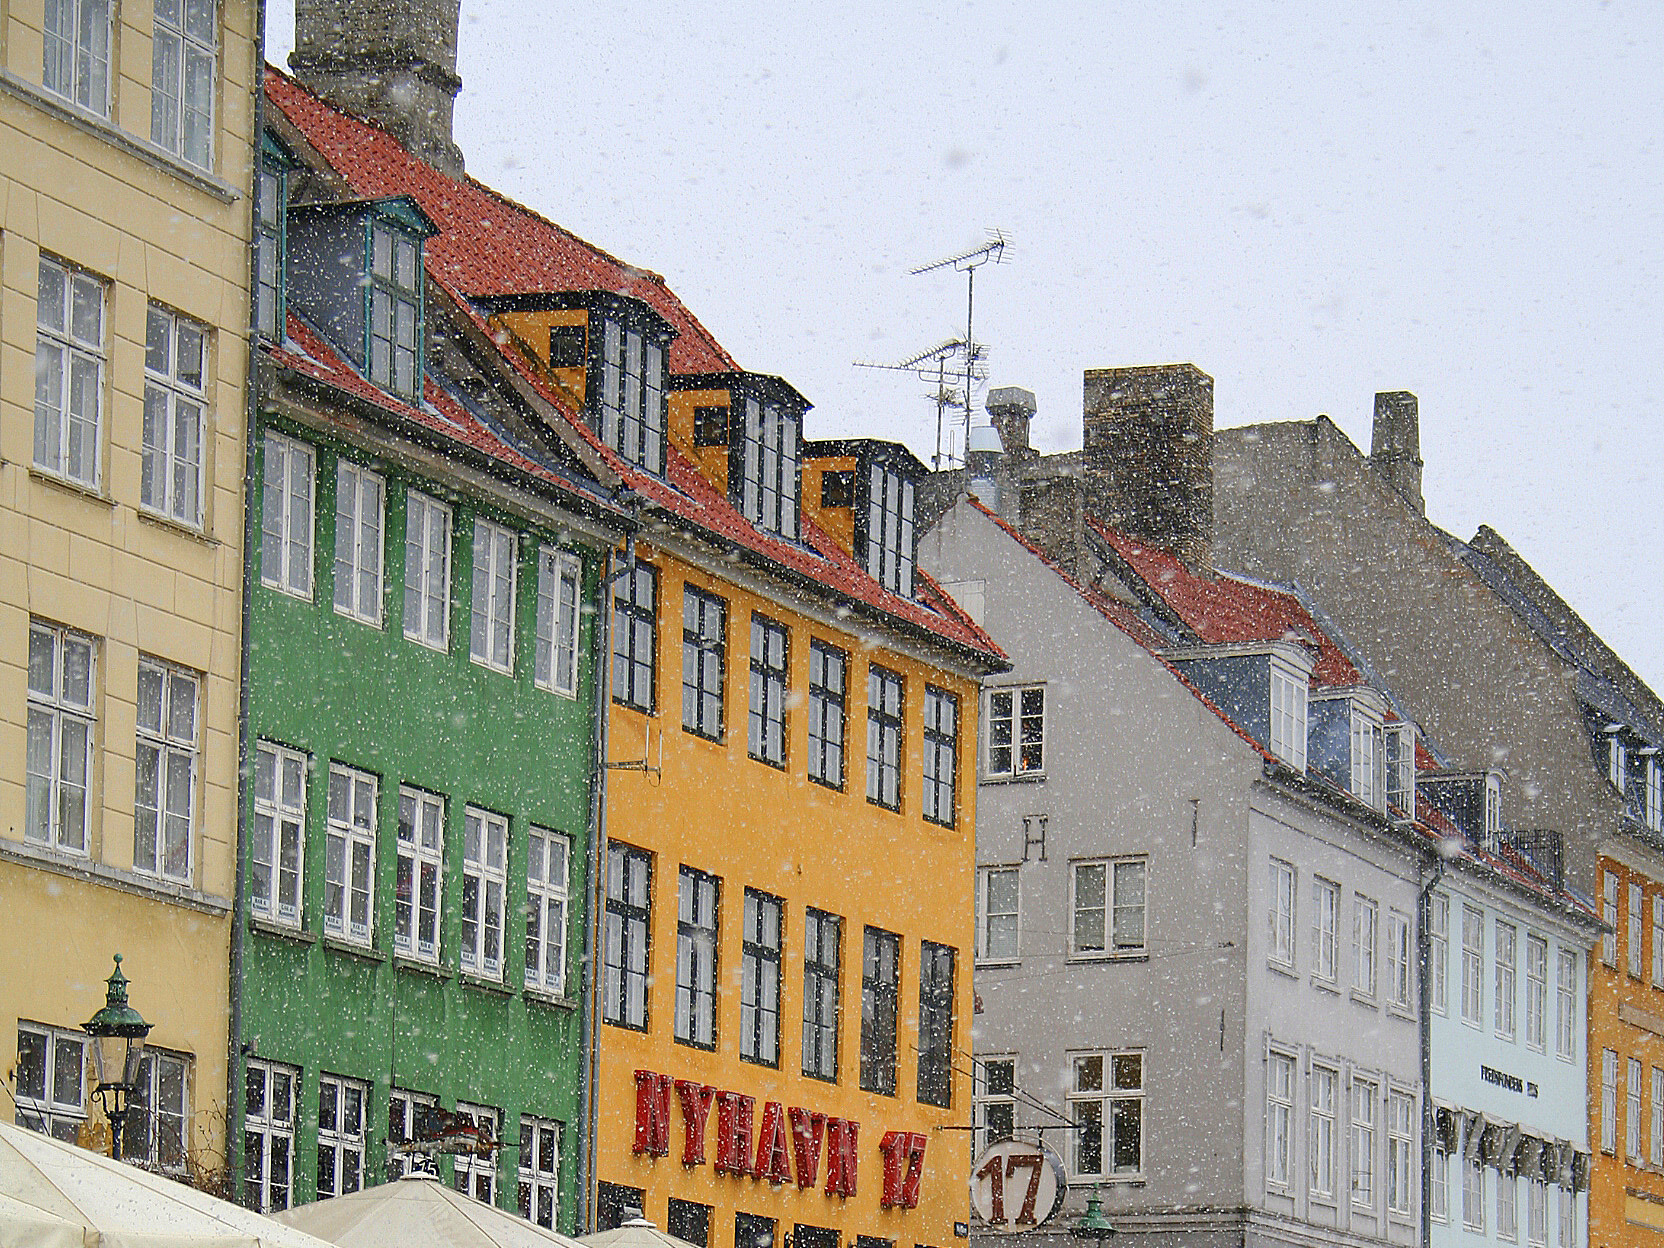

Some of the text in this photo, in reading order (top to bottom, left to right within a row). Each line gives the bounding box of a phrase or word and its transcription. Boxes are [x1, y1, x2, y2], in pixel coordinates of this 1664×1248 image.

[632, 1070, 928, 1209] NYHAVN 17
[976, 1155, 1044, 1225] 17
